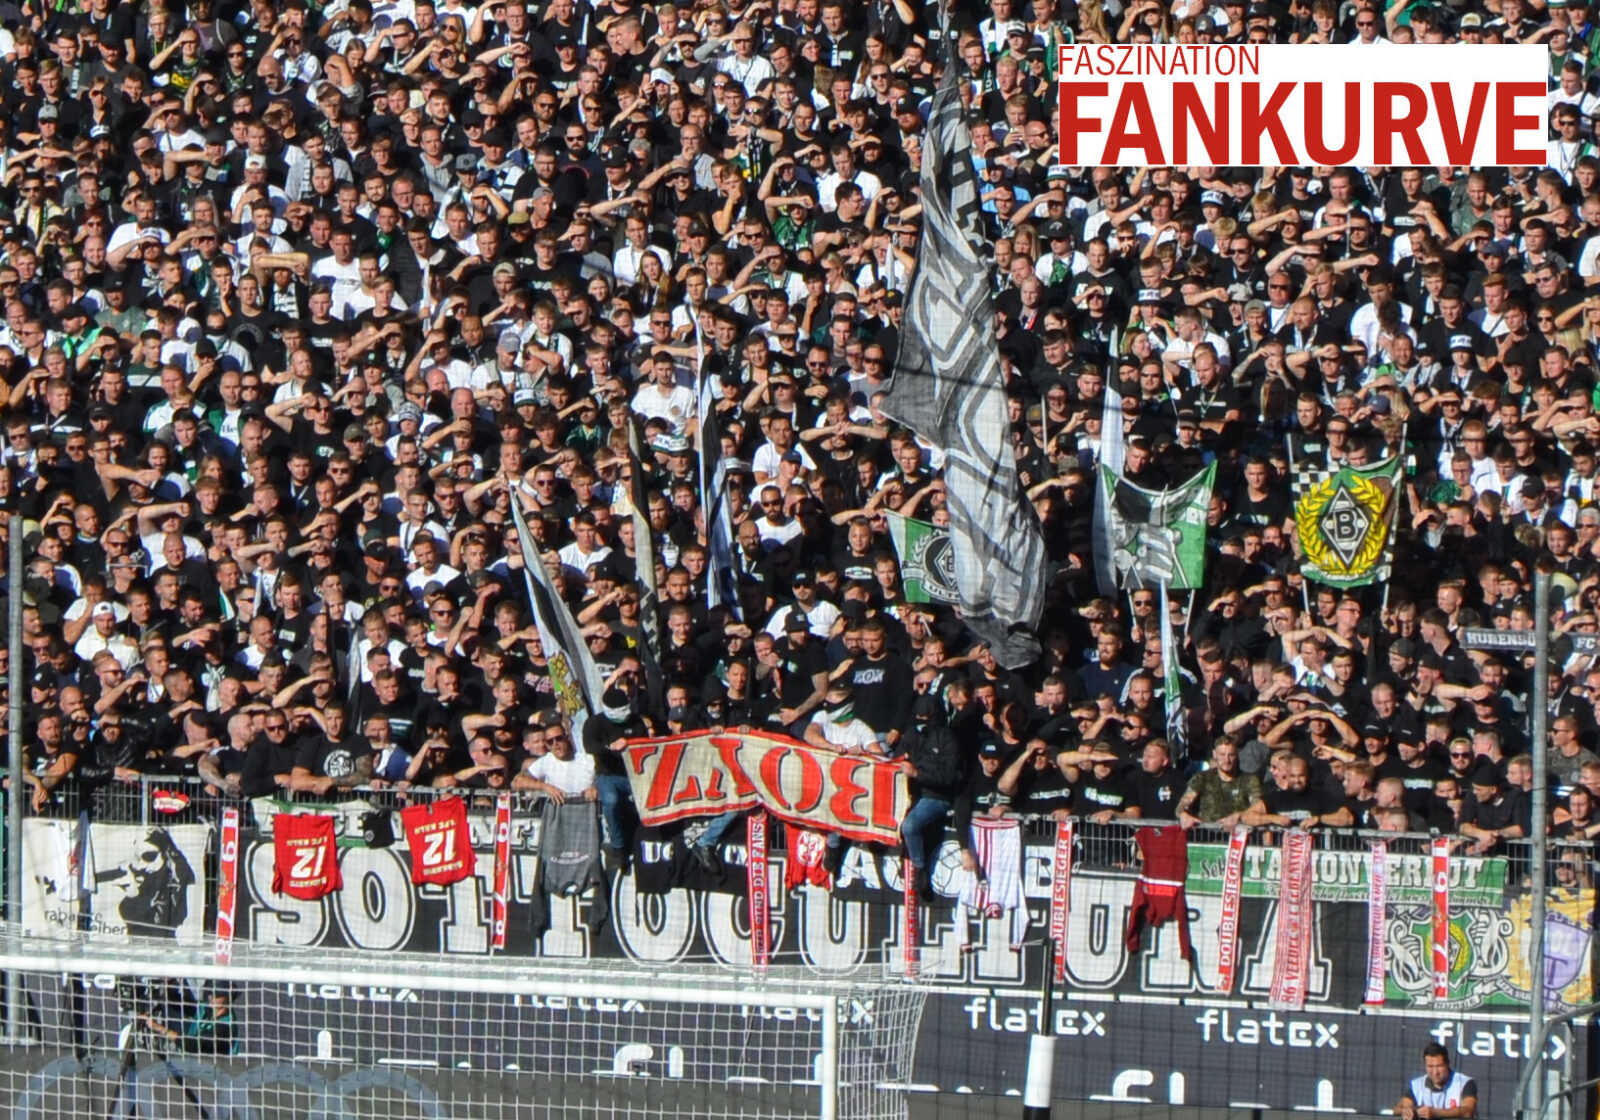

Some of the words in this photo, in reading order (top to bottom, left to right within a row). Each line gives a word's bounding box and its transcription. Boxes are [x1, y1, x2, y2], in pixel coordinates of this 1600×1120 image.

[1466, 631, 1537, 647] HURENSÖ
[629, 738, 904, 830] BOYZ
[422, 828, 456, 867] 12
[752, 823, 765, 859] FANS
[290, 845, 327, 879] 12
[753, 862, 764, 888] DIE
[1052, 838, 1070, 958] DOUBLESIEGER
[1220, 849, 1241, 967] DOUBLESIEGER
[1281, 986, 1298, 1004] 86
[1196, 1008, 1340, 1049] flatex
